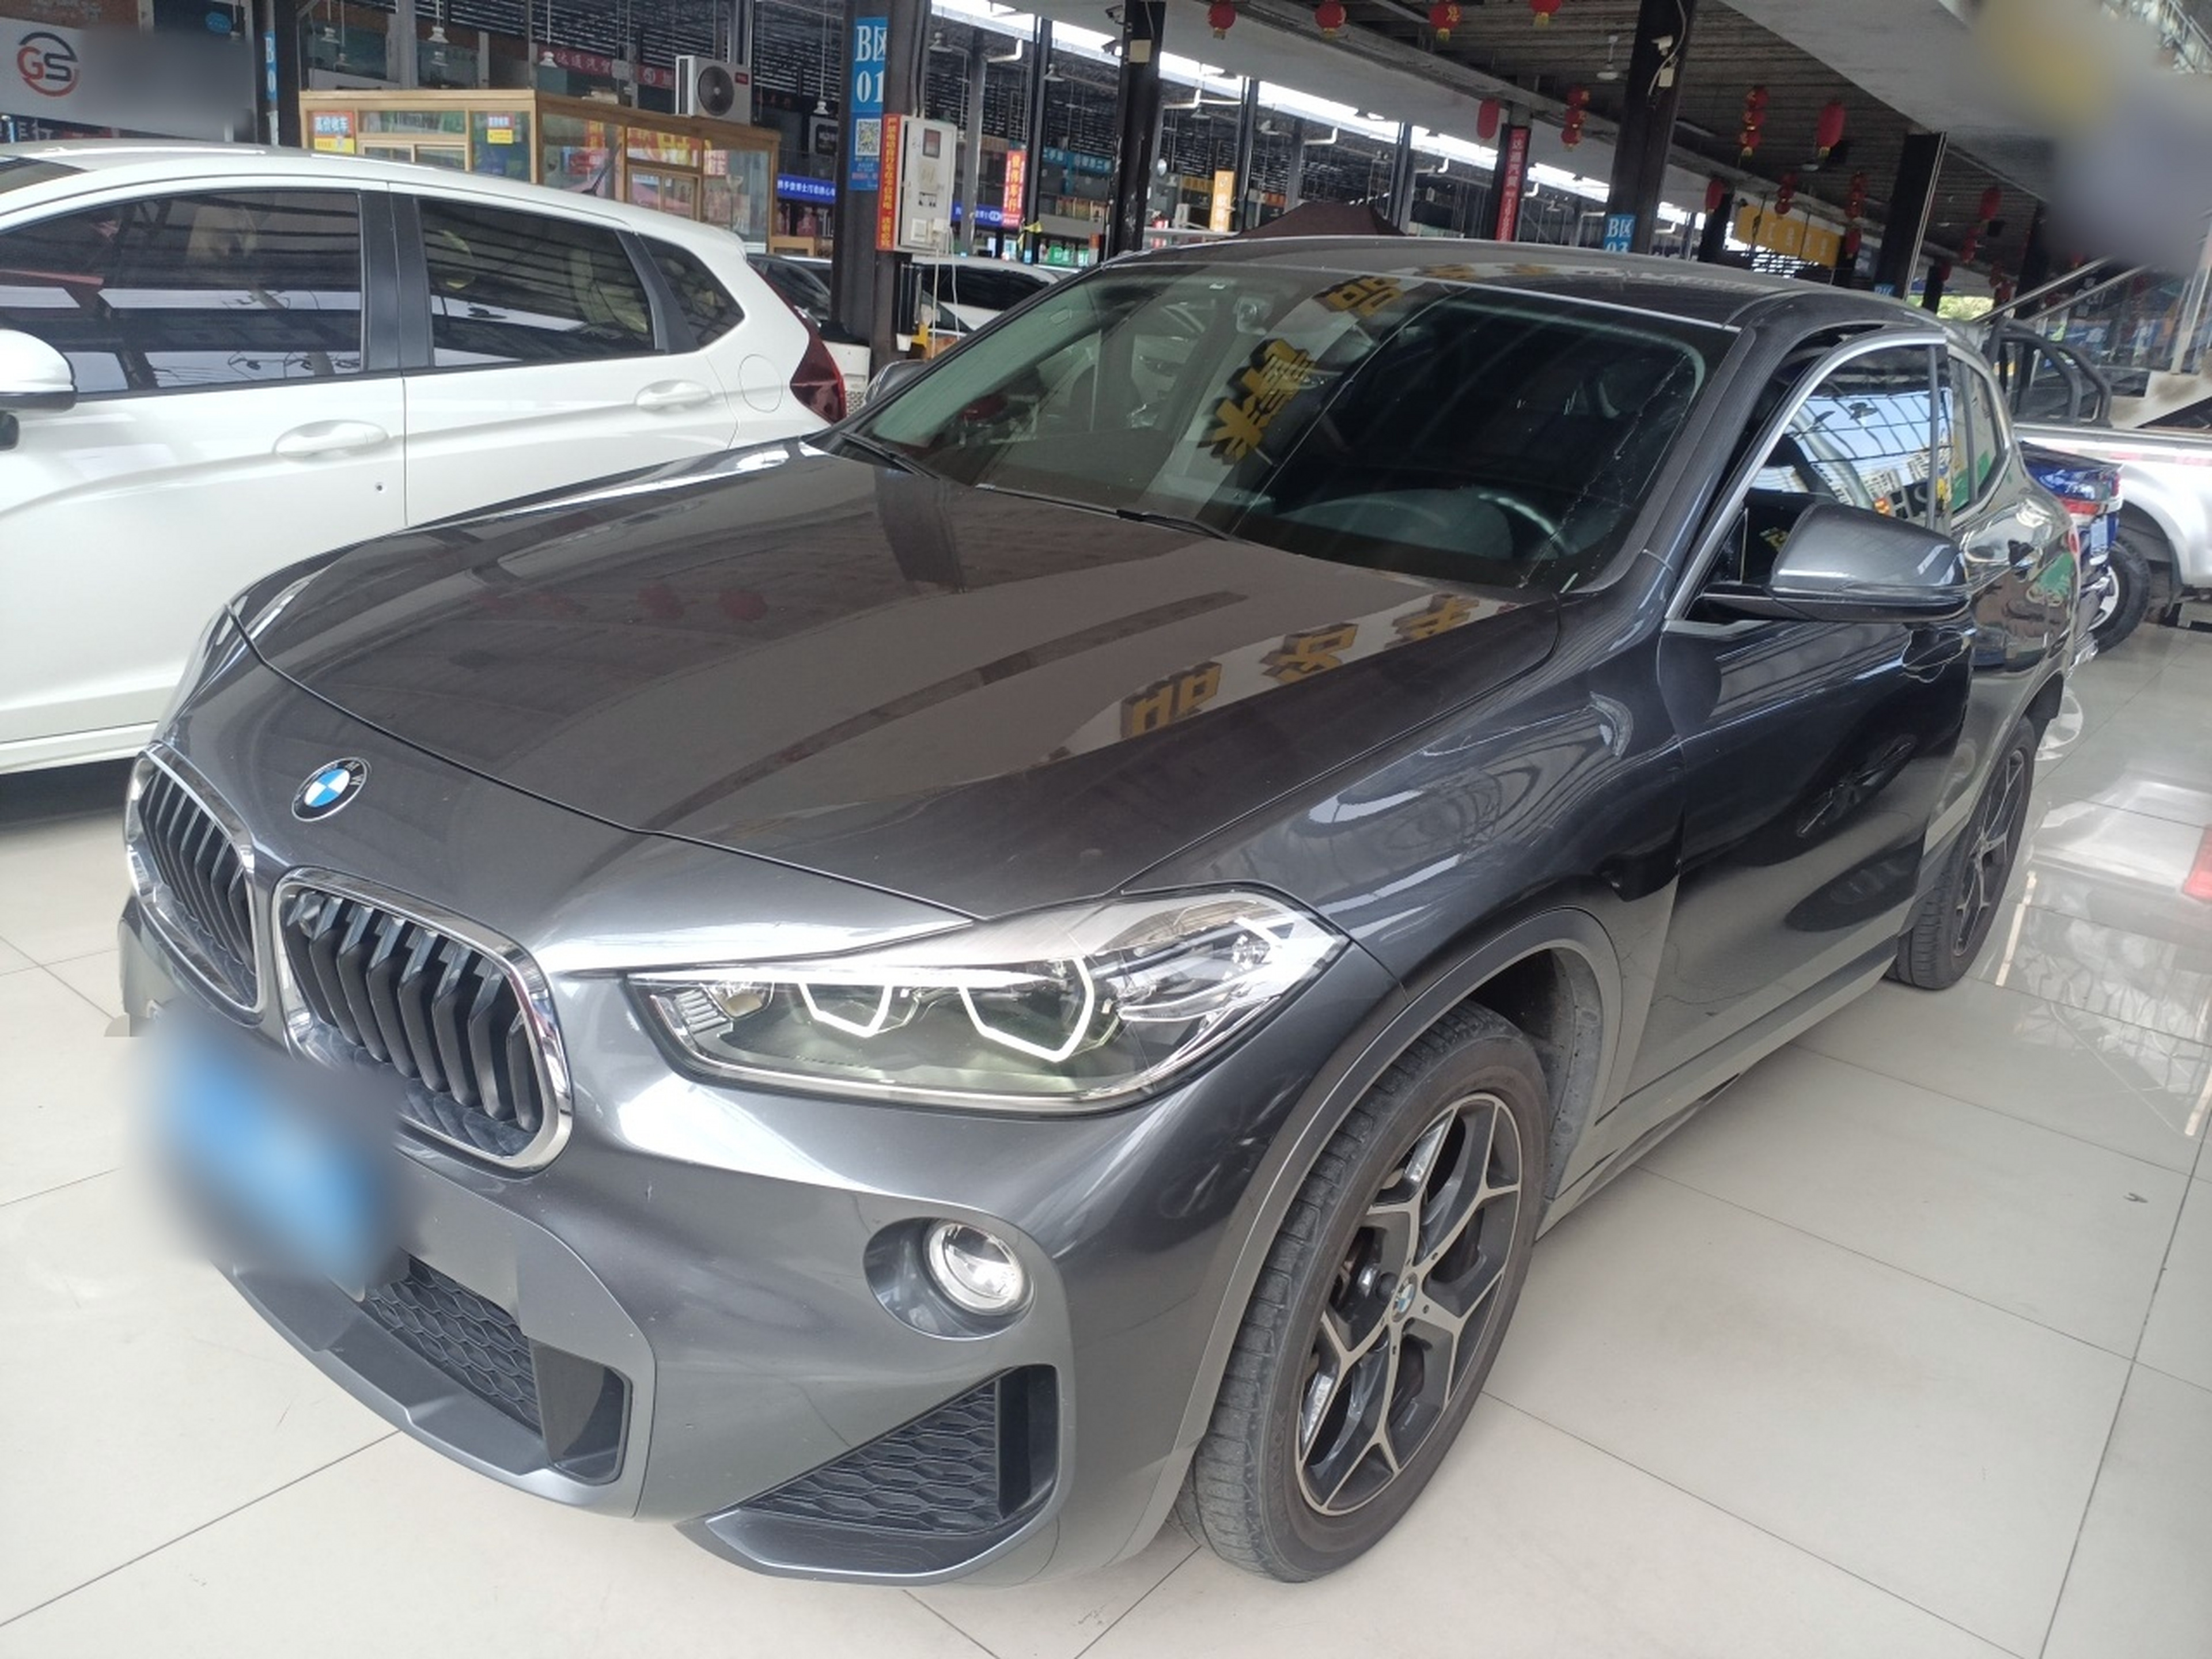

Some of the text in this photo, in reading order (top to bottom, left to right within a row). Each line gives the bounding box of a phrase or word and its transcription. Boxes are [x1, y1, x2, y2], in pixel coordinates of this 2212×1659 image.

[855, 25, 887, 62] B区
[856, 70, 884, 103] 01
[1607, 218, 1634, 237] B区
